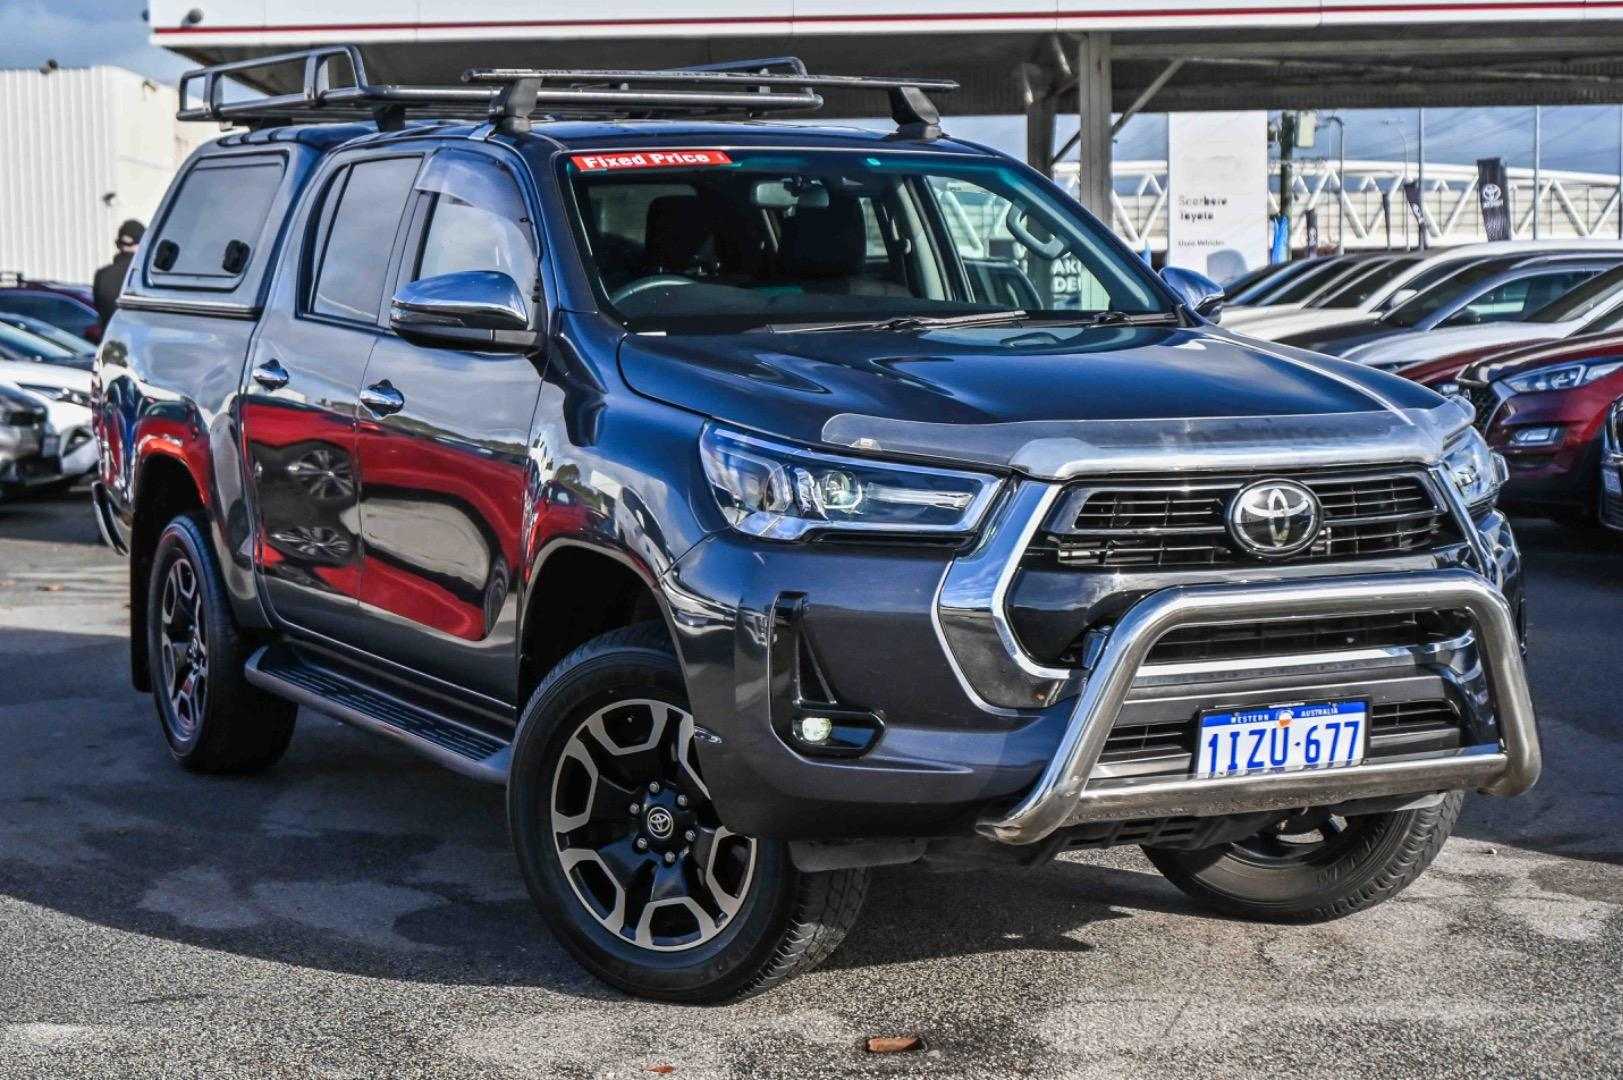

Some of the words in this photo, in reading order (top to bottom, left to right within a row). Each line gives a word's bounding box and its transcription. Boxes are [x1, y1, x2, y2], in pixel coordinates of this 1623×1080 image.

[582, 154, 647, 169] Fixed
[649, 152, 710, 164] Price
[1231, 714, 1269, 723] WESTERN
[1301, 707, 1338, 717] AUSTRALIA
